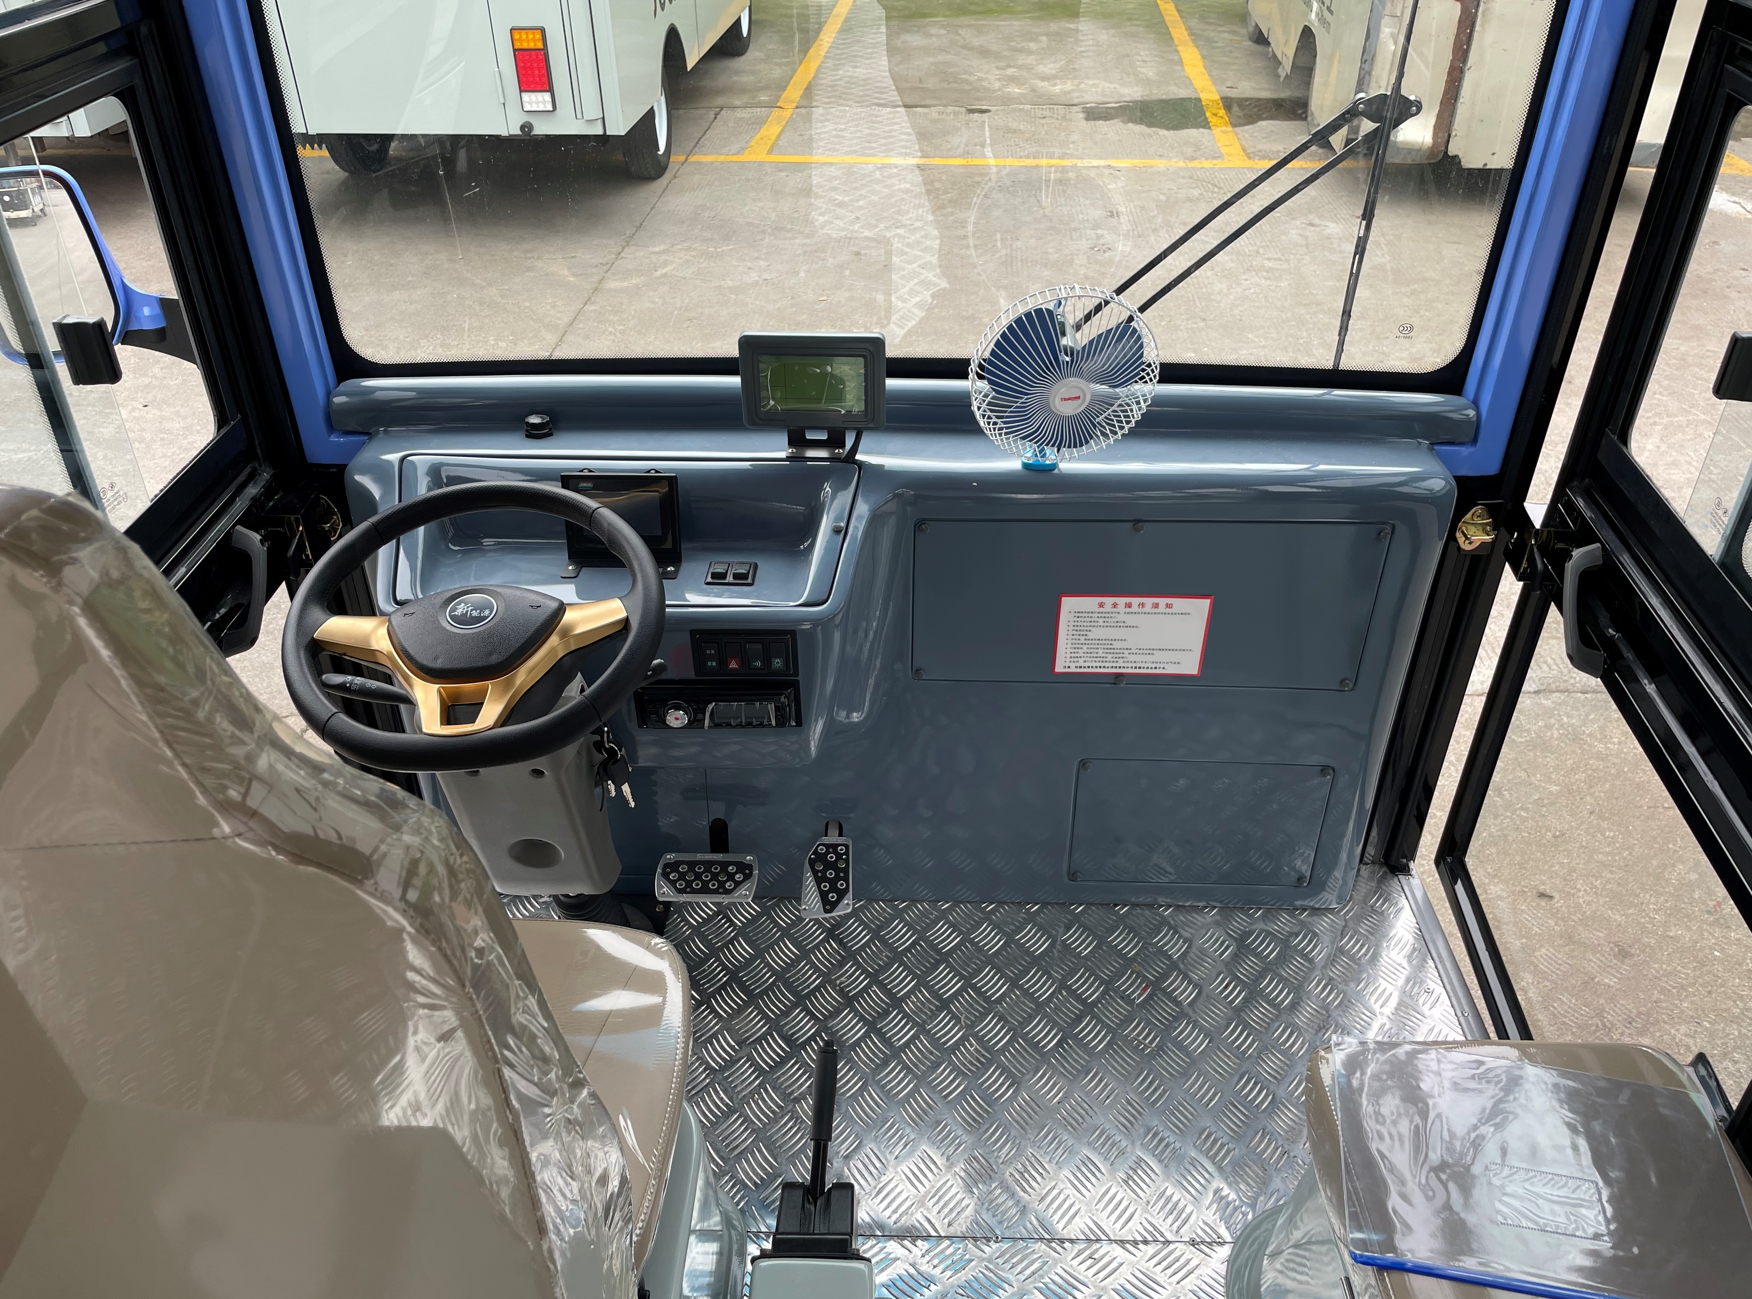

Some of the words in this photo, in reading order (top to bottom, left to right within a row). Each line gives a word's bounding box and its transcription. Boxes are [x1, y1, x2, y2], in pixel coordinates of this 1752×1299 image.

[451, 603, 491, 618] 新能源
[1097, 601, 1174, 609] 安全操作须知
